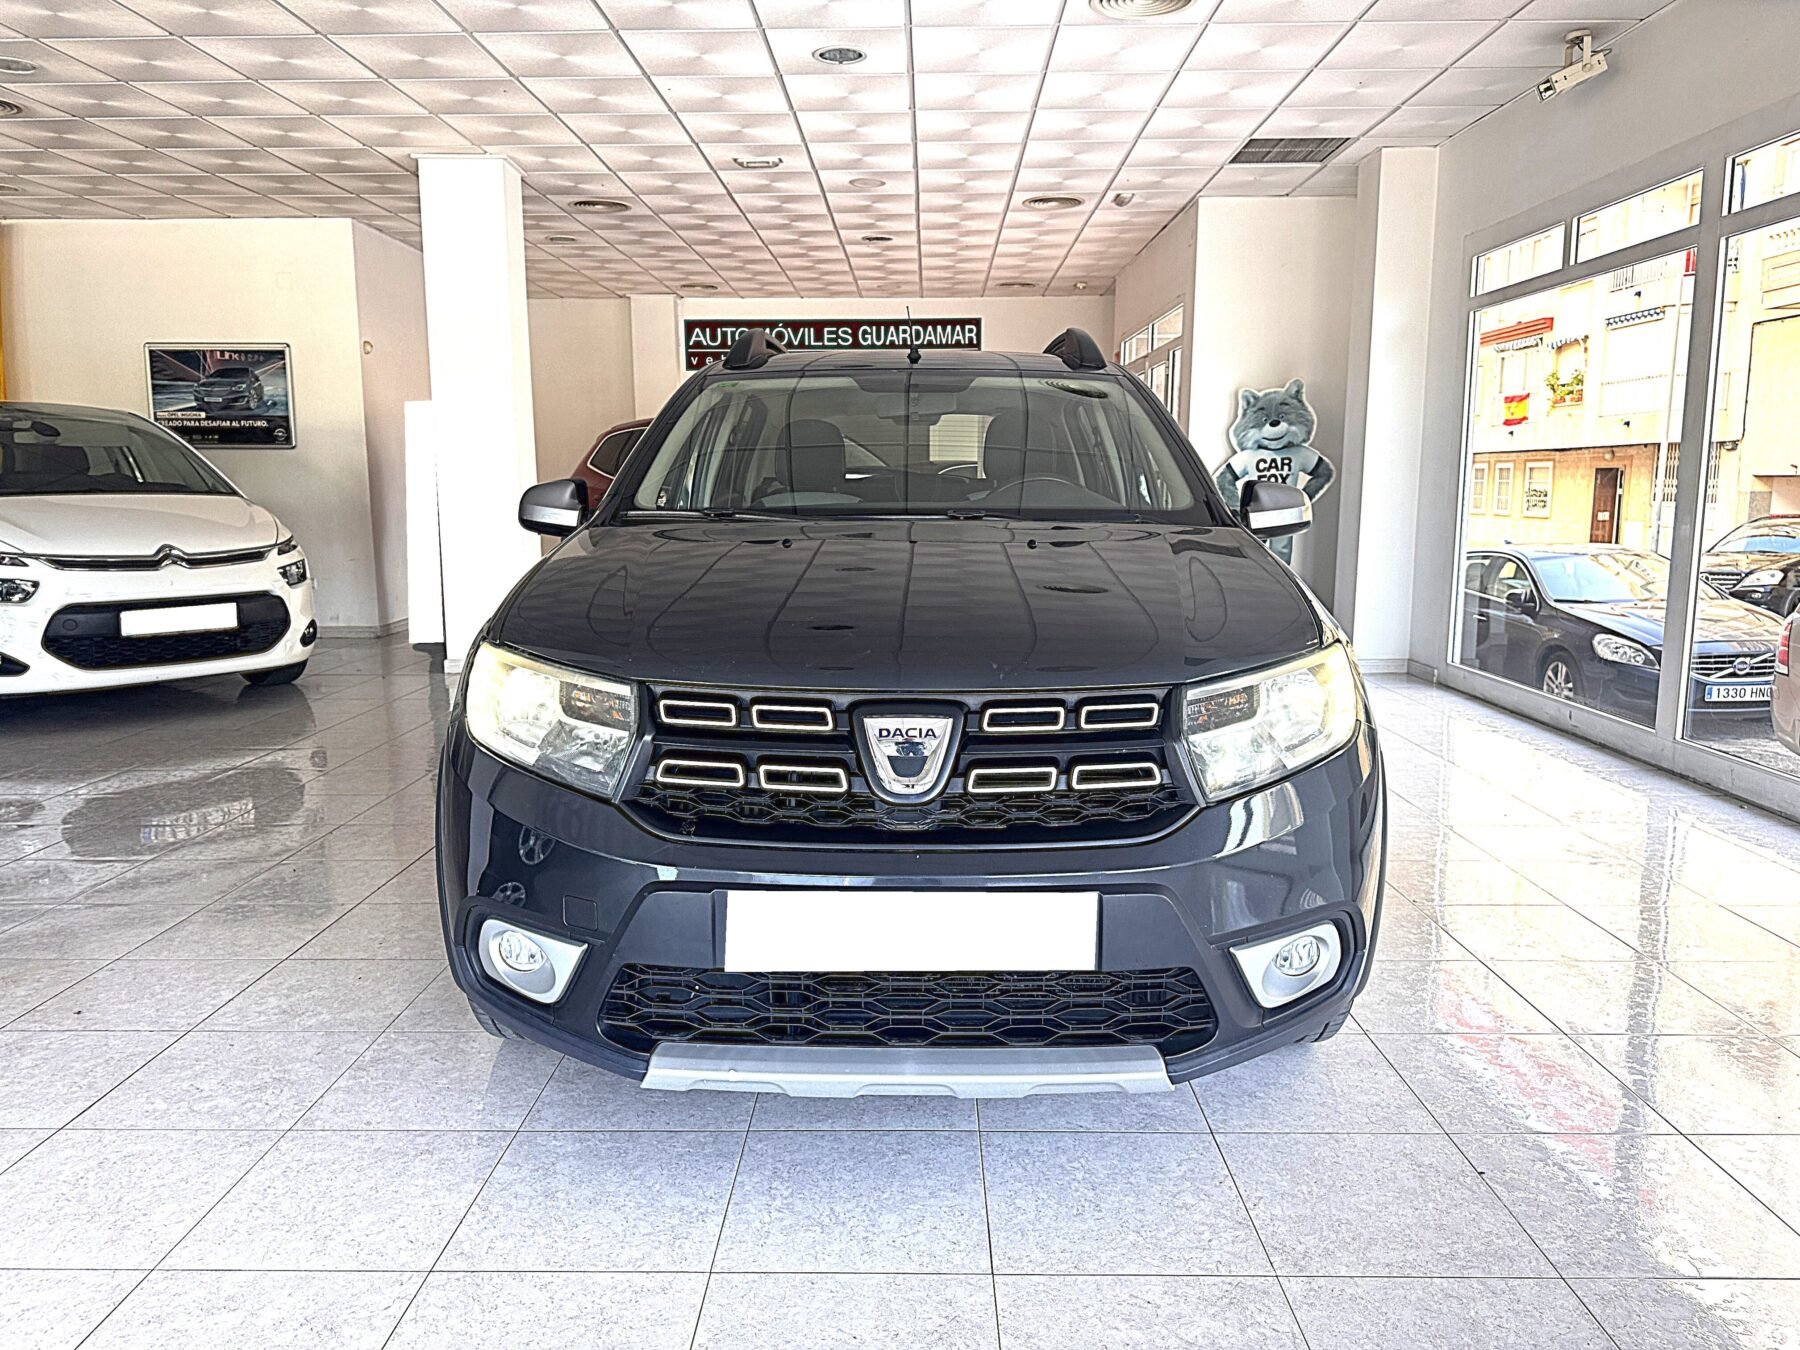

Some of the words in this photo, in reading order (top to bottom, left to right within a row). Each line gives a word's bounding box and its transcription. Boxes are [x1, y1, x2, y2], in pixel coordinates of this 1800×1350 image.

[689, 323, 853, 346] AUTÓVILES
[858, 325, 978, 345] GUARDAMAR
[1255, 456, 1292, 473] CAR
[1716, 687, 1747, 699] 1330
[878, 727, 937, 739] DACIA
